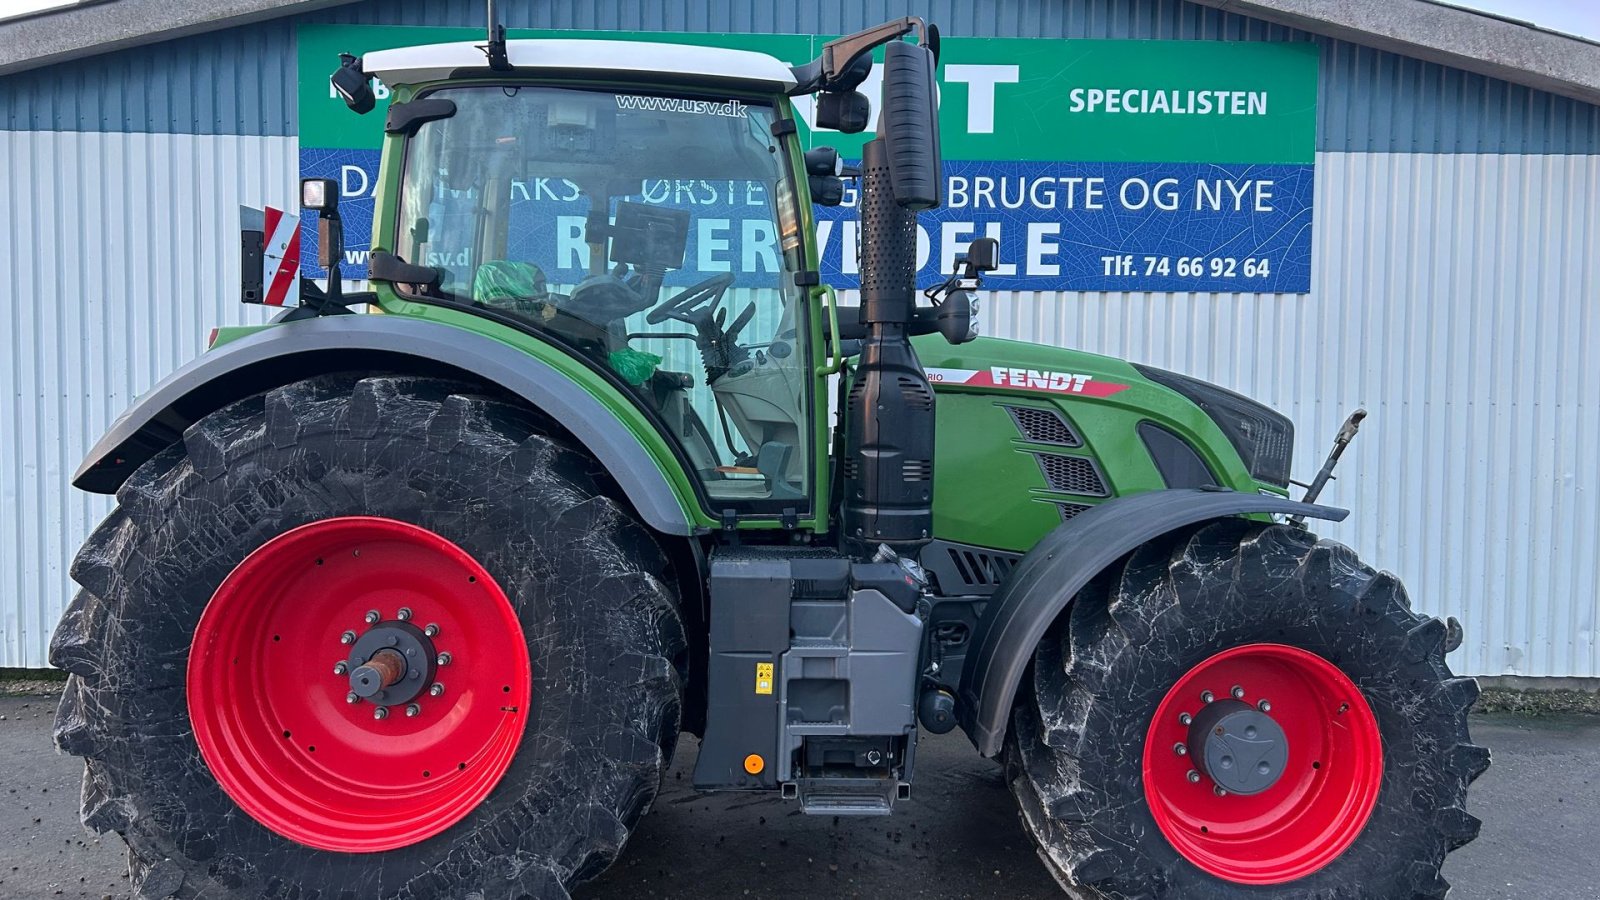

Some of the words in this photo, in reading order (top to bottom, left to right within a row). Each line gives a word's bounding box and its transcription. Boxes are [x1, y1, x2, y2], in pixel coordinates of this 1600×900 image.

[615, 94, 748, 119] www.usv.dk
[1069, 88, 1268, 115] SPECIALISTEN
[948, 176, 1105, 210] BRUGTE
[1119, 177, 1179, 211] OG
[1196, 179, 1274, 212] NYE
[1101, 255, 1137, 276] Tlf.
[1144, 256, 1170, 276] 74
[1176, 257, 1203, 277] 66
[1210, 257, 1236, 277] 92
[1243, 258, 1270, 278] 64
[990, 366, 1093, 393] FENDT
